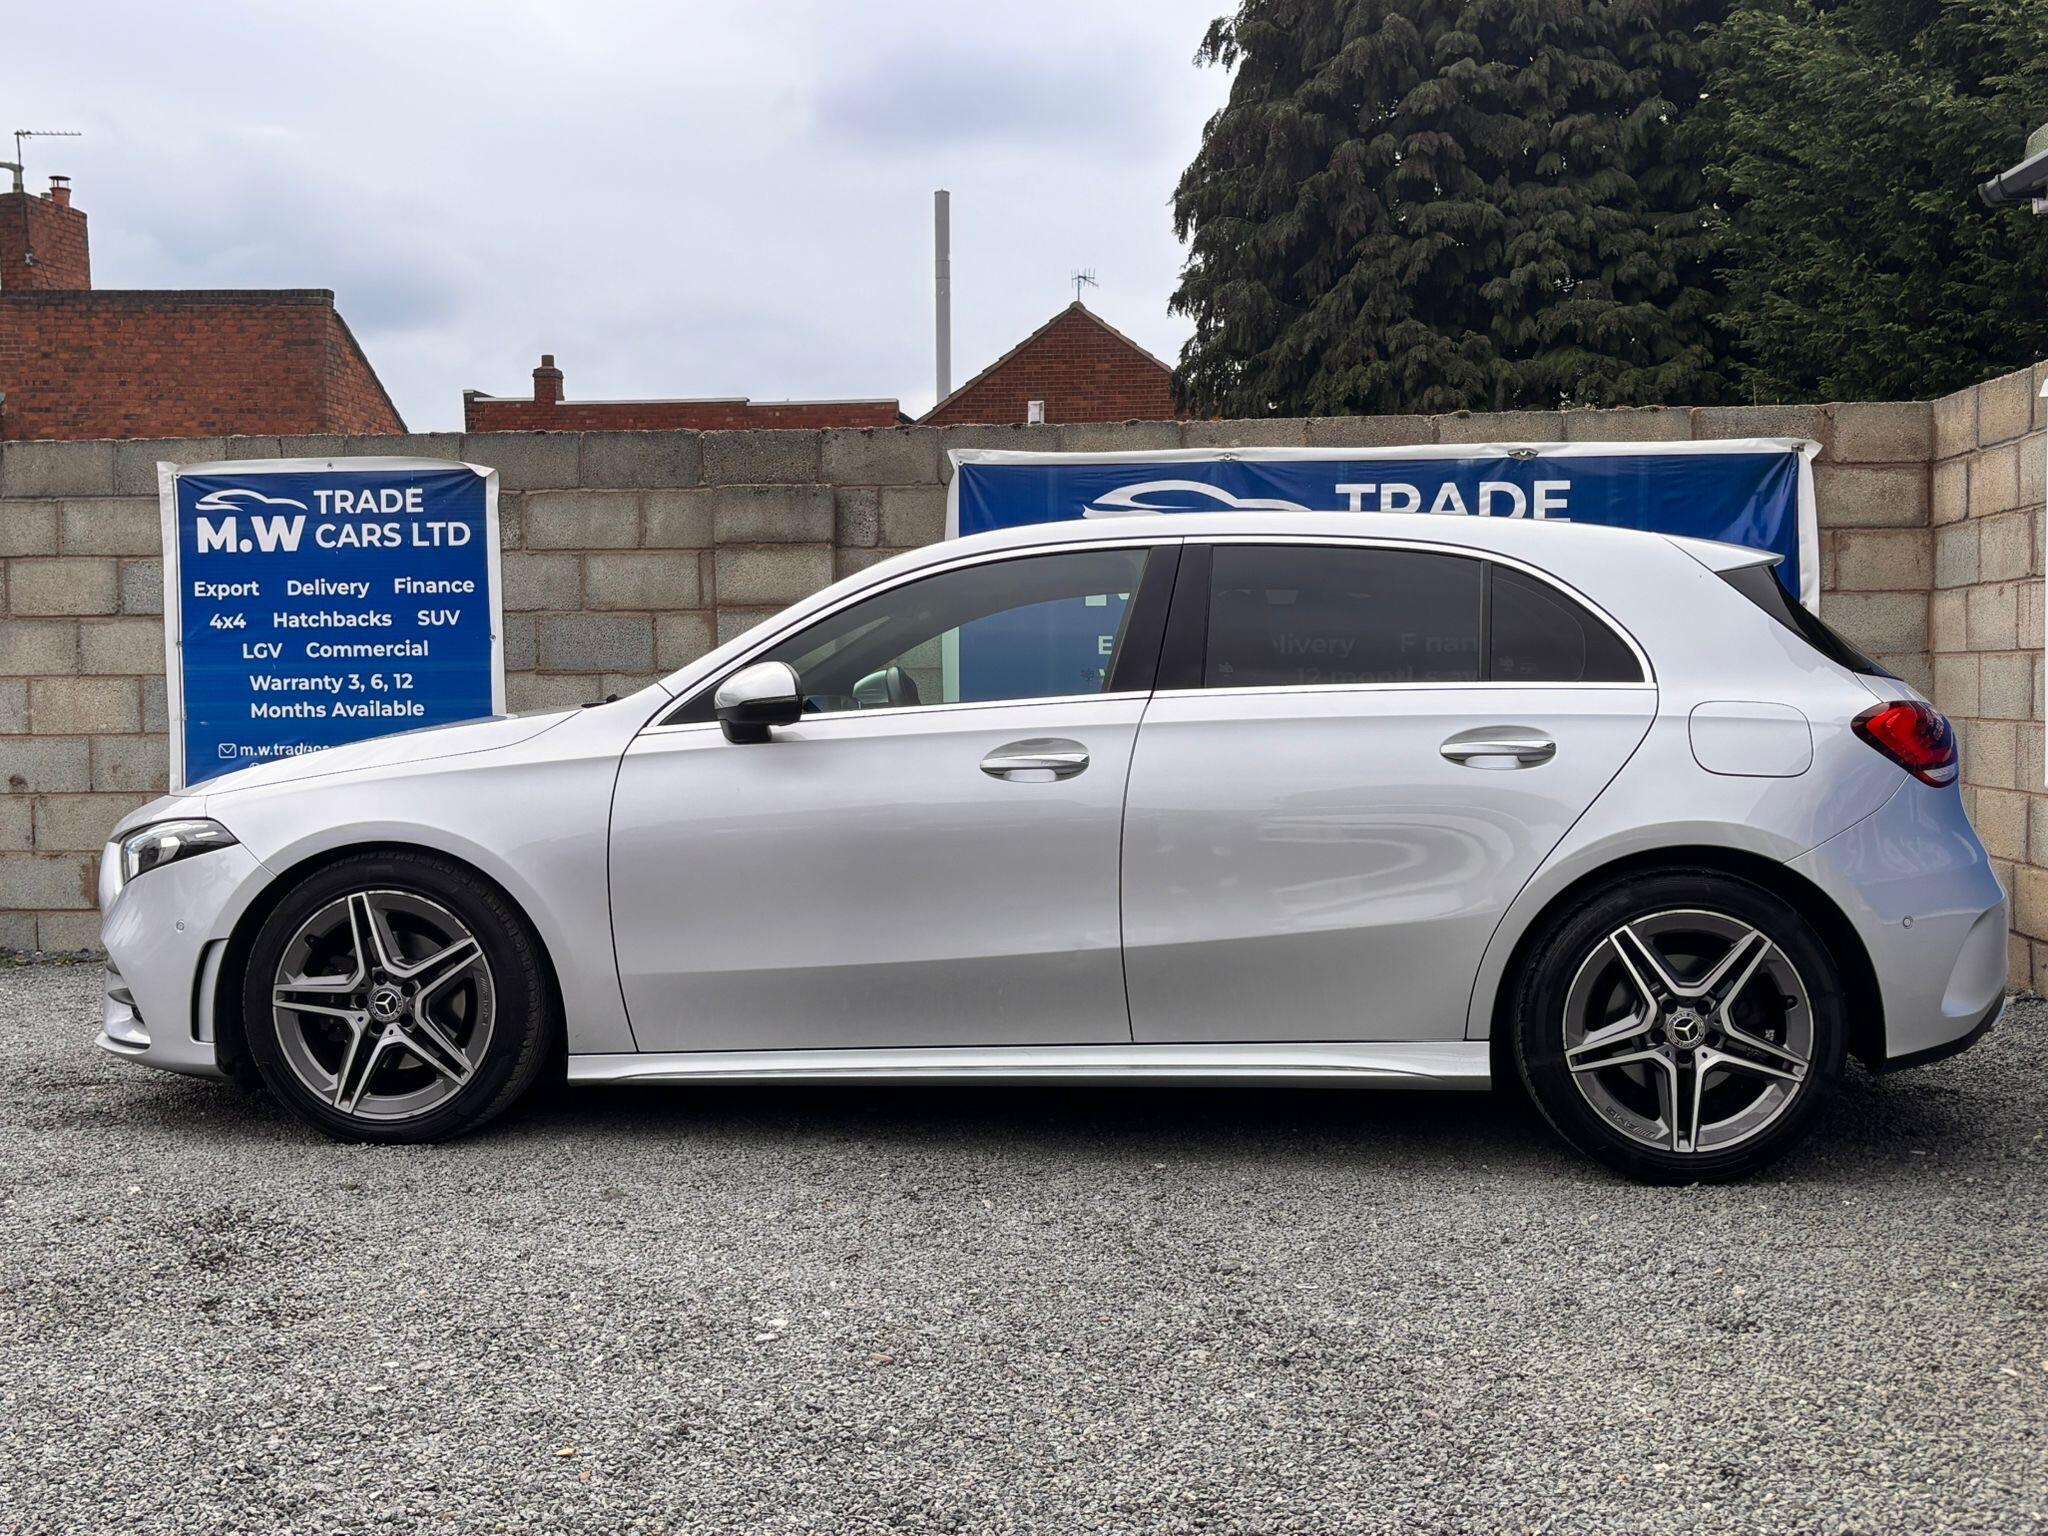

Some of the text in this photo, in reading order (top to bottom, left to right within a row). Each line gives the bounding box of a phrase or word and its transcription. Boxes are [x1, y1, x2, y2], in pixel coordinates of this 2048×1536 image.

[313, 488, 424, 515] TRADE
[1335, 480, 1571, 522] TRADE
[196, 515, 307, 553] M.W
[315, 521, 471, 548] CARS LTD
[194, 576, 475, 600] Export Delivery Finance
[209, 609, 461, 629] 4x4 Hatchbacks SUV
[242, 639, 429, 659] LGV Commercial
[249, 673, 414, 693] Warranty 3, 6, 12
[250, 699, 425, 719] Months Available
